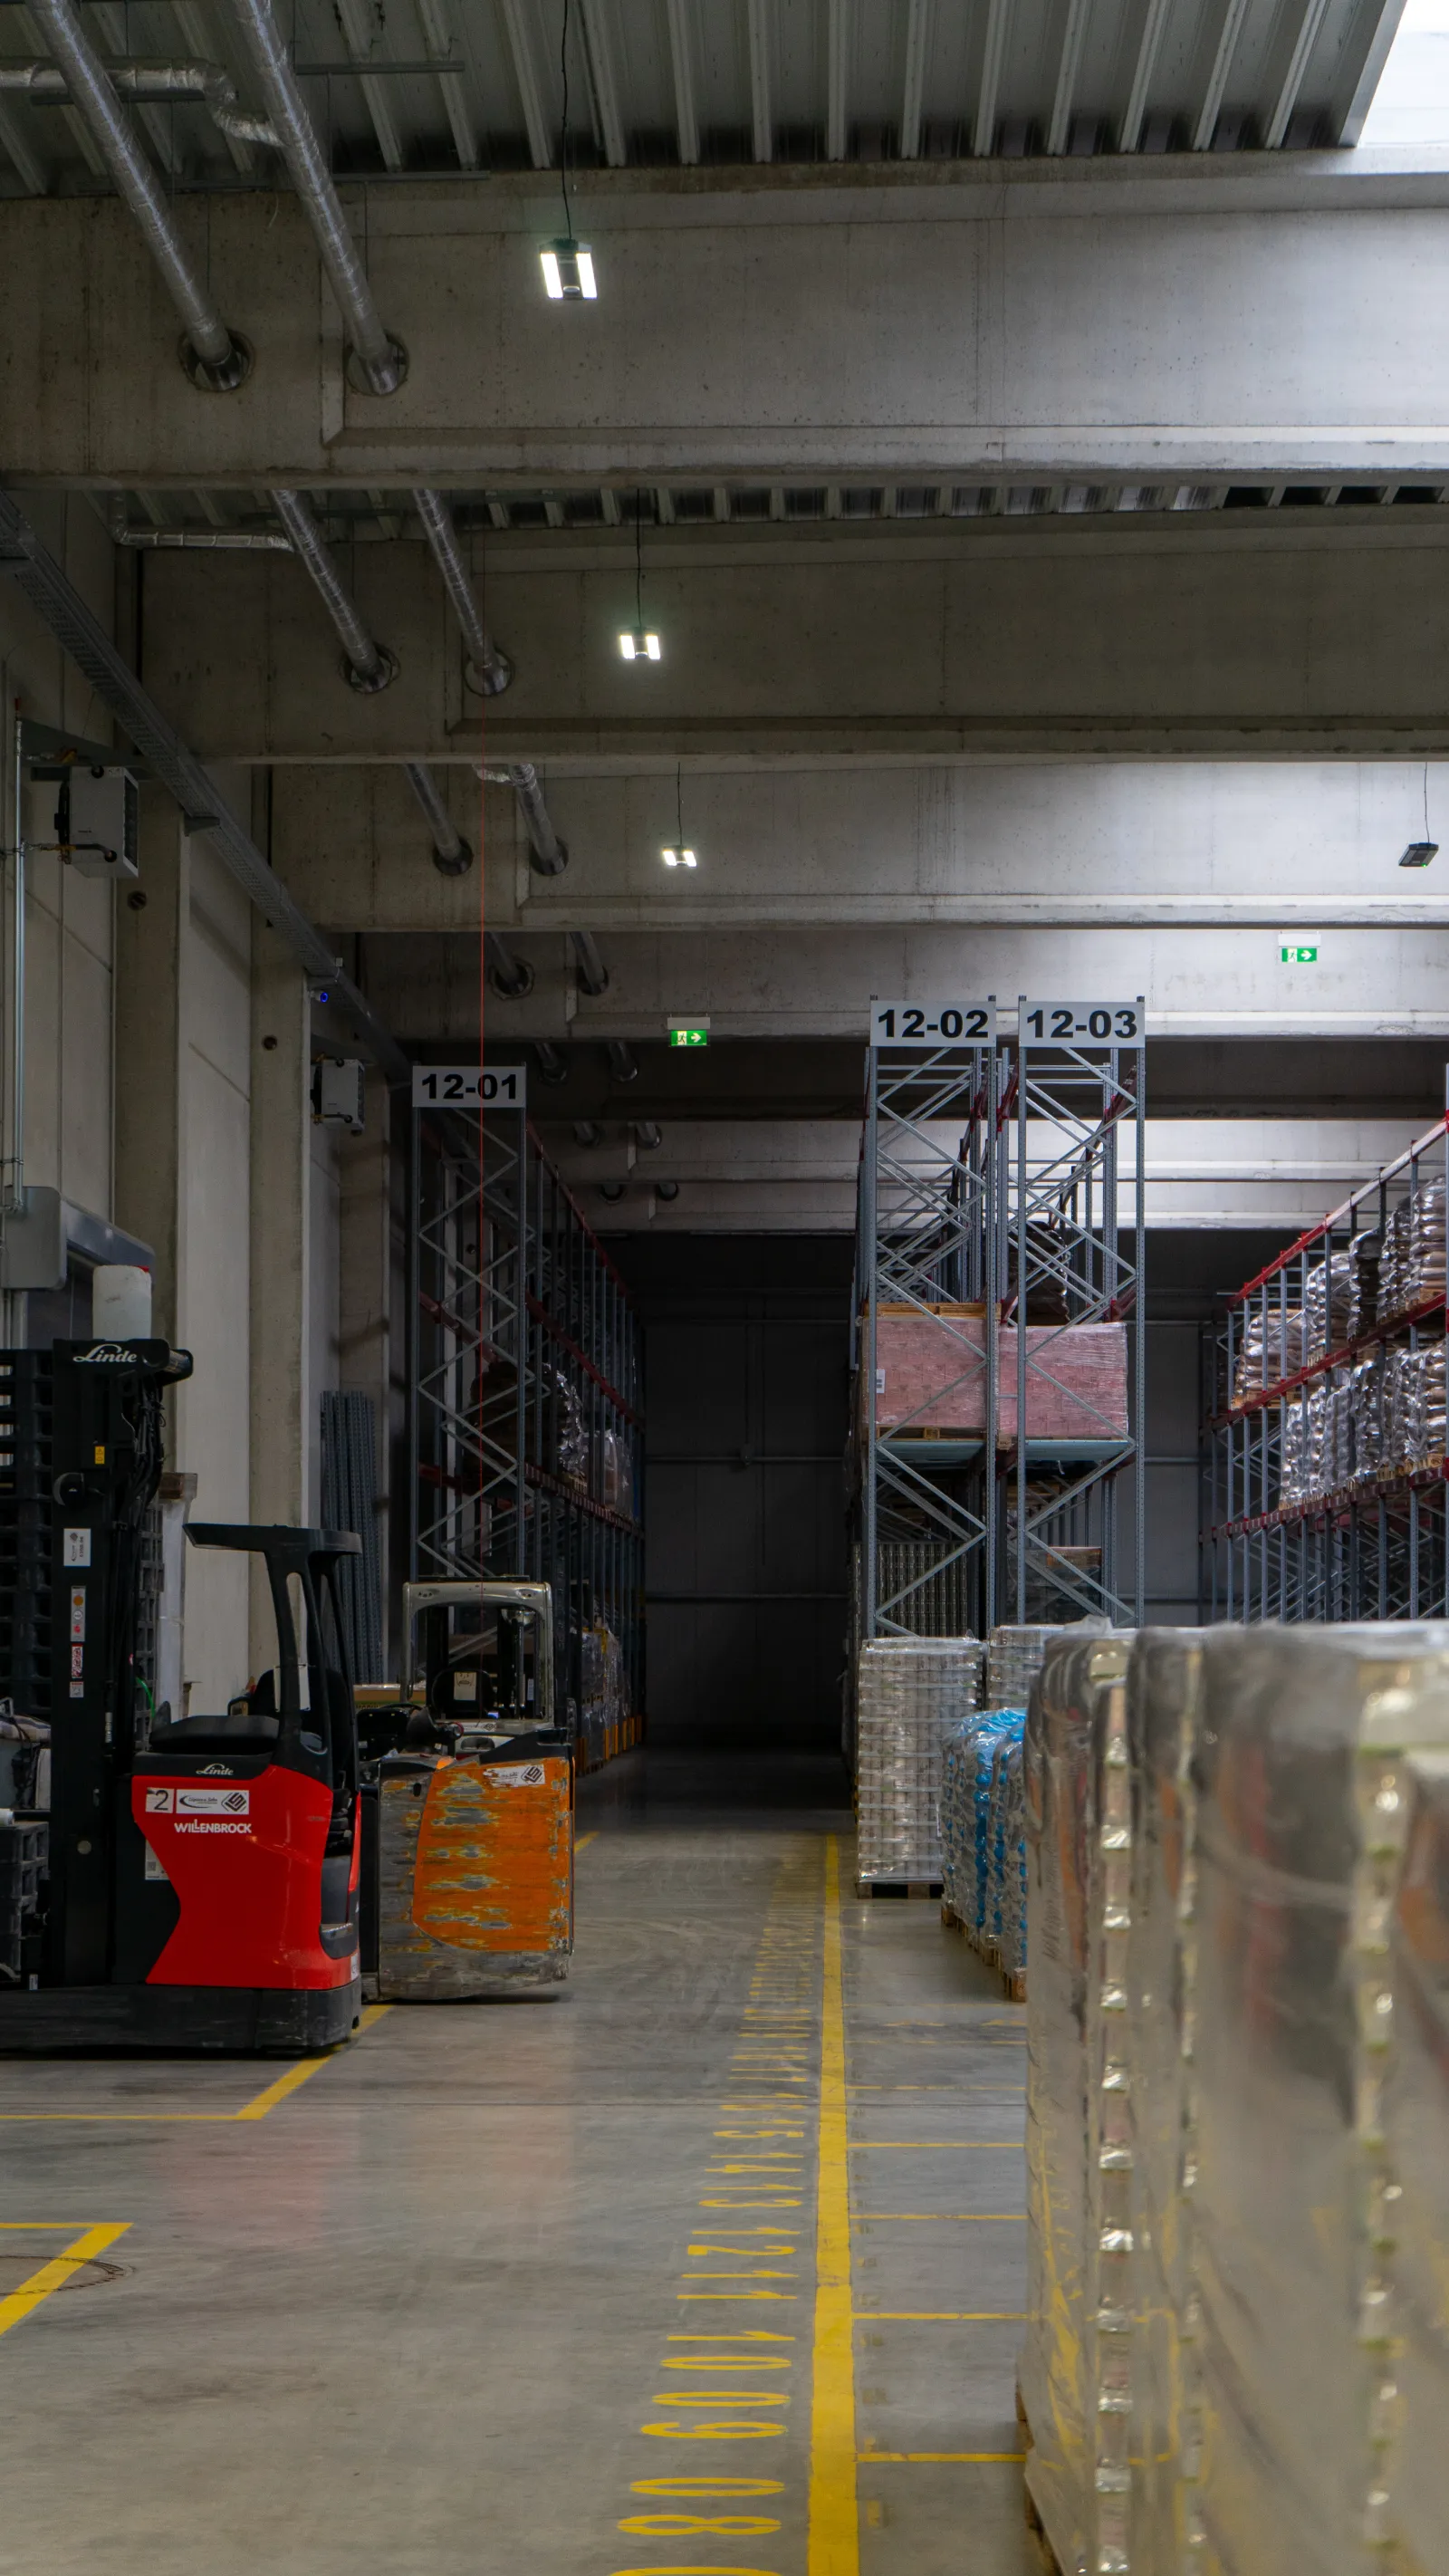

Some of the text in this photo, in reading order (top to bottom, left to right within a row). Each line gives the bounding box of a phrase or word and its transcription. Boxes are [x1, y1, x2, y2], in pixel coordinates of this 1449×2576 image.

[878, 1009, 989, 1038] 12-02
[1027, 1009, 1137, 1039] 12-03
[422, 1073, 516, 1100] 12-01
[72, 1343, 138, 1363] Linde
[196, 1763, 234, 1775] Linde
[154, 1790, 169, 1811] 2
[174, 1819, 252, 1833] WILLENBROCK
[714, 2119, 807, 2137] 15
[705, 2152, 805, 2173] 14
[699, 2184, 804, 2207] 13
[687, 2227, 801, 2255] 12
[677, 2270, 800, 2299] 11
[660, 2331, 795, 2370] 10
[617, 2477, 785, 2535] 08
